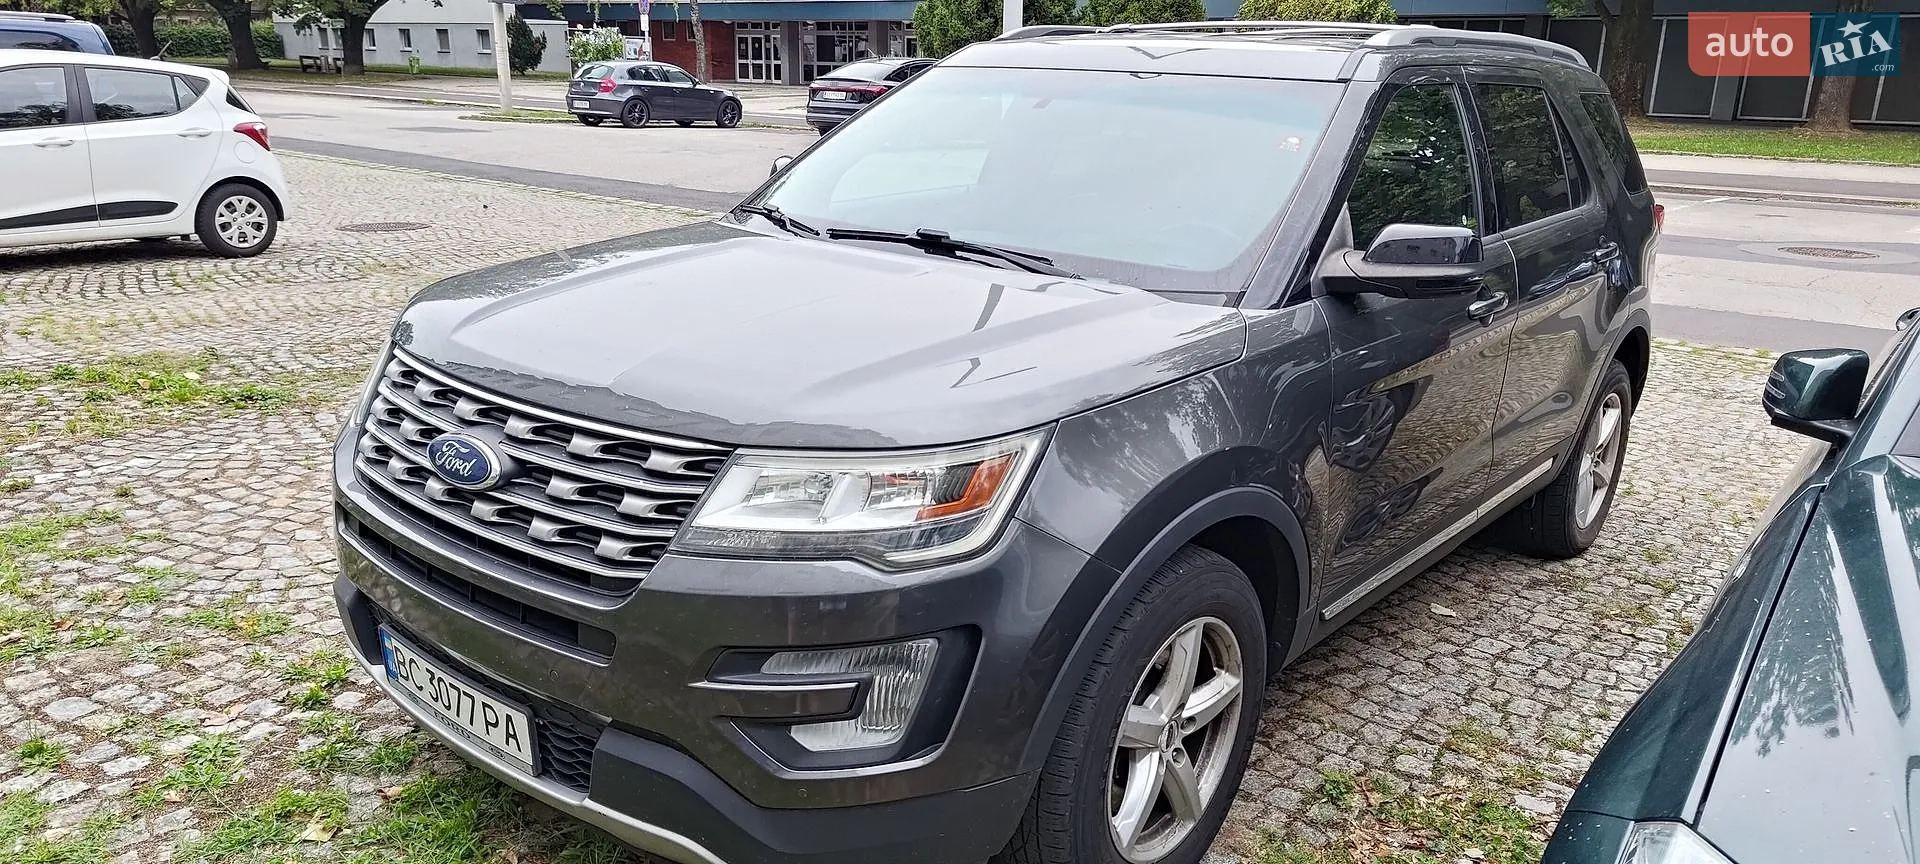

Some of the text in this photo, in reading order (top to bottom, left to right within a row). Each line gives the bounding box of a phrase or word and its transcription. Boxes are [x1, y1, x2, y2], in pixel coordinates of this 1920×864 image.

[435, 441, 478, 476] Ford
[394, 645, 522, 752] BC 3077 PA
